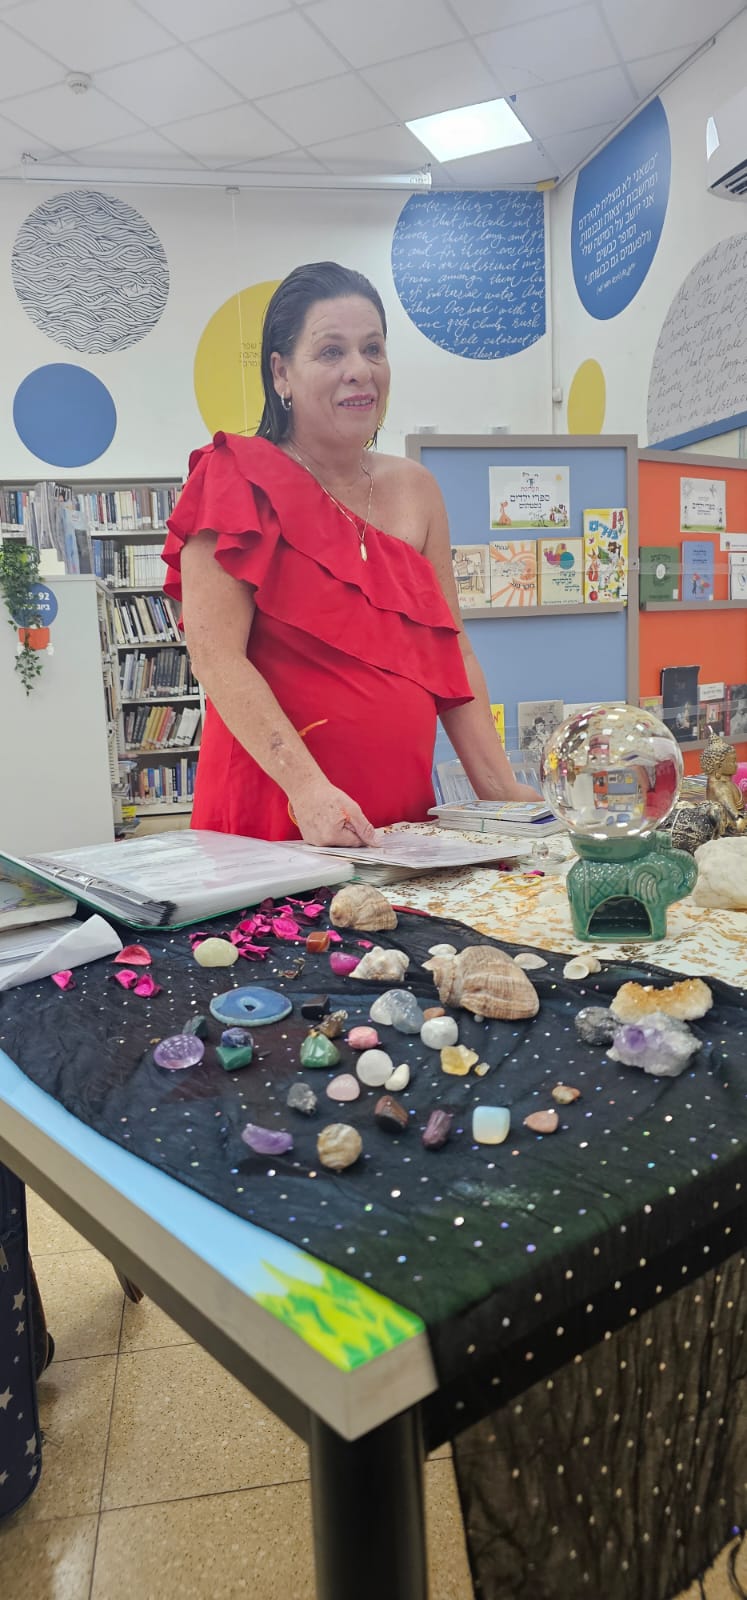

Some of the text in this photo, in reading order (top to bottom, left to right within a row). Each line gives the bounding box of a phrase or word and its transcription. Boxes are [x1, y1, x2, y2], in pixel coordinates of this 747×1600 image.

[622, 175, 632, 193] לא
[626, 171, 658, 207] ומחשבות
[600, 186, 621, 211] מצליח
[642, 191, 655, 209] אני
[614, 216, 624, 231] על
[581, 242, 593, 256] שלי
[596, 223, 637, 263] וסופר כבשים
[610, 253, 619, 268] גם
[532, 494, 550, 502] ספרי
